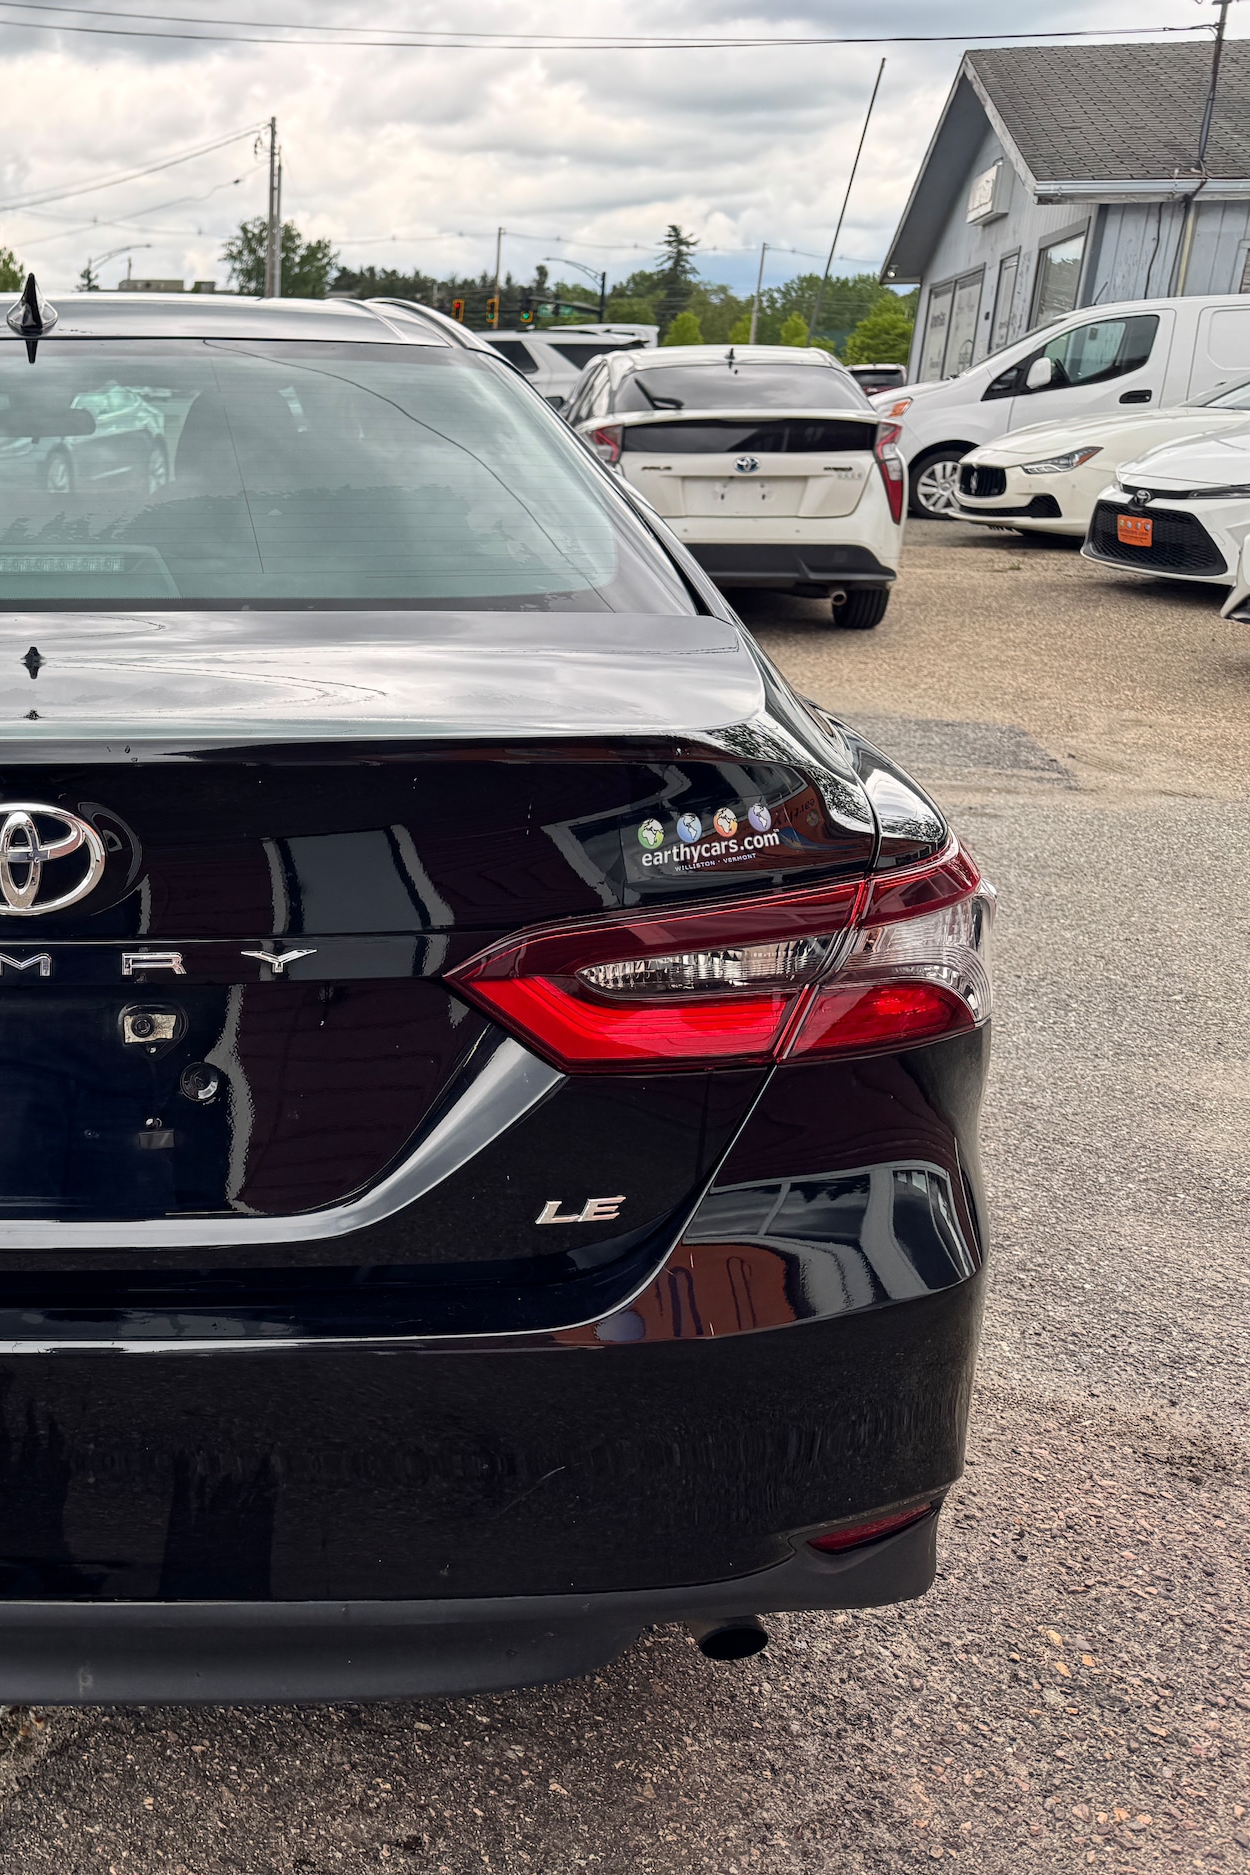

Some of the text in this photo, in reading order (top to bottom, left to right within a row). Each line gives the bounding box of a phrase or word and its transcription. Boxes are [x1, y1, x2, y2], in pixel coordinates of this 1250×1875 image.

[641, 831, 779, 867] earthycars.com
[674, 852, 757, 872] WILLISTON VERMONT
[535, 1195, 626, 1224] LE
